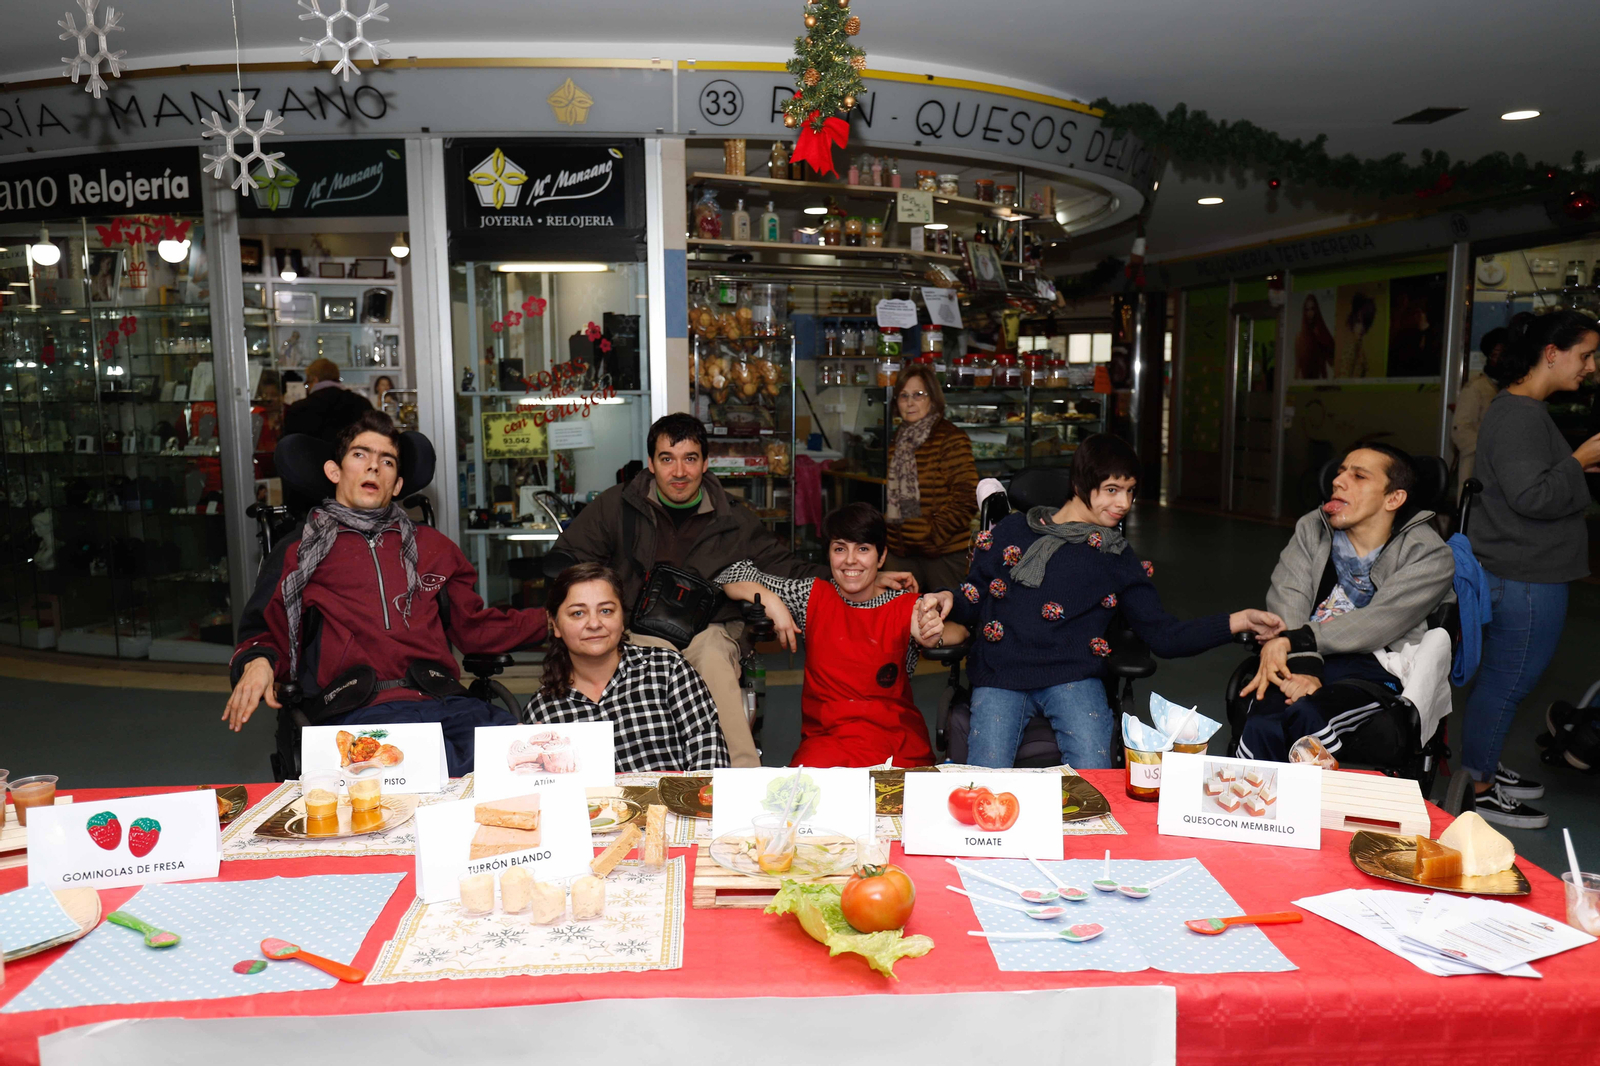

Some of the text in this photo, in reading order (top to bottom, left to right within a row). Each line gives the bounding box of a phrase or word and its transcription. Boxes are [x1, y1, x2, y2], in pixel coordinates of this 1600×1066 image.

[105, 85, 388, 129] MANZANO
[705, 90, 738, 116] 33
[771, 86, 876, 128] PN
[916, 100, 1078, 154] QUESOS
[68, 168, 190, 208] Relojería
[327, 161, 384, 199] Manzano
[551, 160, 613, 197] Manzano
[480, 215, 614, 228] JOYERIA RELOJERIA
[1452, 218, 1468, 233] 18
[1275, 241, 1310, 263] TETE
[1310, 233, 1375, 258] PEREIRA
[504, 418, 528, 434] con
[534, 382, 617, 428] corazón
[503, 437, 531, 445] 93.042
[1144, 767, 1161, 779] US
[1183, 814, 1295, 834] QUESOCON MEMBRILLO
[965, 837, 1002, 846] TOMATE
[62, 860, 185, 882] GOMINOLAS DE FRESA
[468, 851, 552, 875] TURRÓN BLANDO
